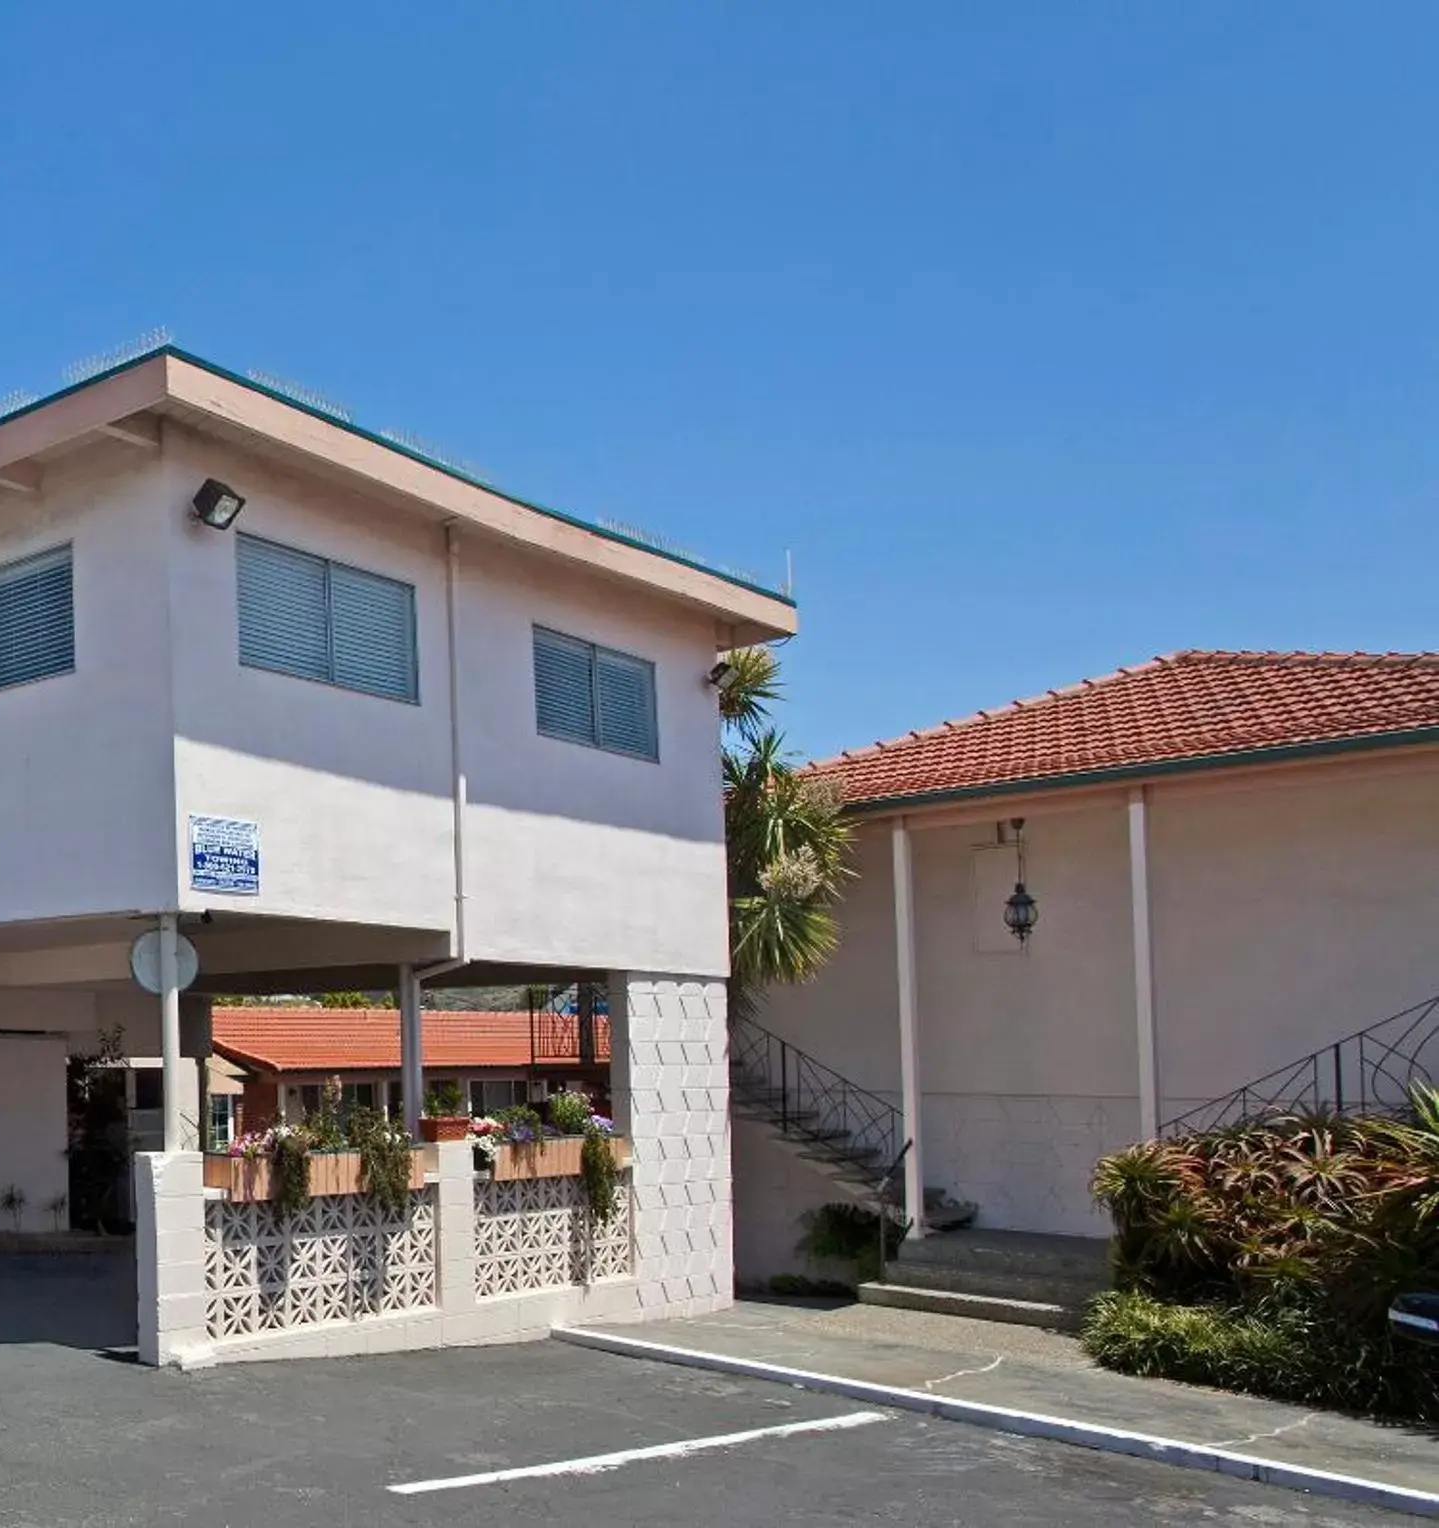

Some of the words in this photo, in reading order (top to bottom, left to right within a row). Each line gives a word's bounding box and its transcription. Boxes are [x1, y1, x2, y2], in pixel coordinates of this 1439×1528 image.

[194, 843, 220, 854] BLUE
[223, 847, 256, 860] WATER
[206, 854, 249, 865] TOWING
